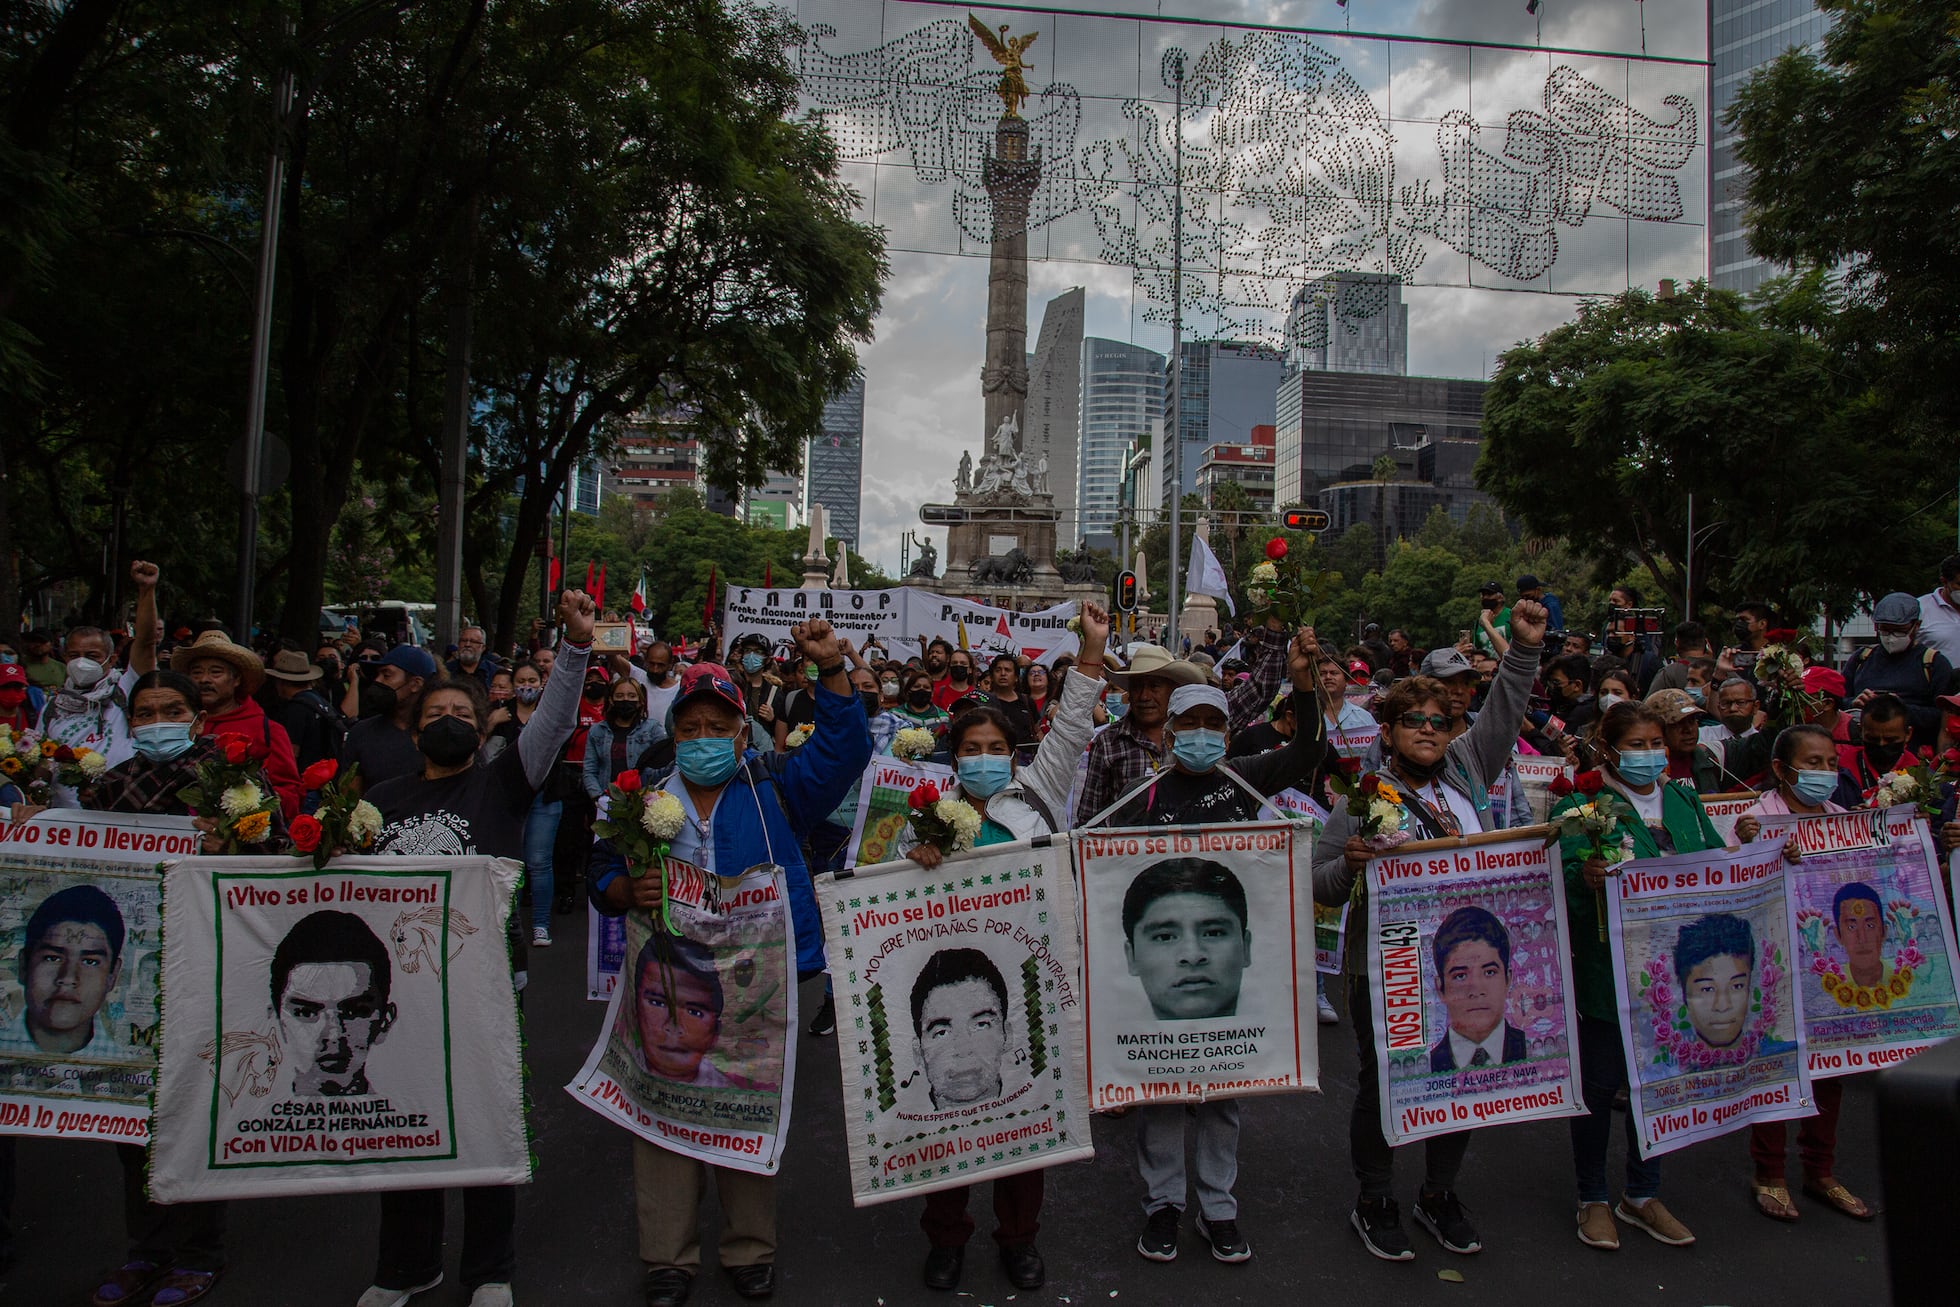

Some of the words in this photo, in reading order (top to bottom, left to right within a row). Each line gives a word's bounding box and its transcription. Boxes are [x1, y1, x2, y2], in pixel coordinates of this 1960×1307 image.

[729, 602, 757, 614] Frente
[761, 606, 806, 619] Nacional
[808, 611, 821, 619] de
[825, 610, 888, 621] Movimientos
[941, 604, 997, 627] Poder
[1008, 612, 1069, 632] Popular
[876, 768, 915, 788] ¡Vivo
[424, 809, 470, 828] ETADO
[1797, 820, 1826, 852] NOS
[1826, 813, 1871, 848] FALTAN
[46, 827, 71, 845] se
[77, 826, 98, 848] lo
[104, 828, 197, 855] llevaron!
[1086, 838, 1139, 860] ¡Vivo
[1145, 836, 1167, 855] se
[1173, 834, 1192, 853] lo
[1199, 831, 1286, 852] llevaron!
[1378, 860, 1423, 886] ¡Vivo
[1428, 858, 1449, 875] se
[1453, 852, 1471, 873] lo
[1475, 845, 1546, 871] llevaron!
[1622, 872, 1669, 898] ¡Vivo
[1674, 872, 1698, 888] se
[1705, 866, 1723, 886] lo
[1730, 857, 1783, 884] llevaron!
[227, 885, 280, 909] ¡Vivo
[286, 887, 307, 905] se
[314, 882, 334, 903] lo
[340, 881, 437, 903] llevaron!
[853, 911, 899, 935] ¡Vivo
[903, 907, 923, 922] se
[927, 900, 945, 919] lo
[948, 884, 1031, 915] llevaron!
[1381, 920, 1418, 947] 43!
[863, 933, 904, 983] MOVERE
[907, 919, 978, 944] MONTAÑAS
[984, 918, 1012, 935] POR
[1013, 926, 1077, 1012] ENCONTRARTE
[1384, 946, 1419, 1009] FALTAN
[1117, 1032, 1174, 1045] MARTÍN
[1178, 1027, 1266, 1044] GETSEMANY
[1388, 1011, 1421, 1048] NOS
[1813, 1022, 1855, 1036] Marcial
[1861, 1020, 1888, 1031] Pablo
[1893, 1013, 1934, 1026] Baranda
[1127, 1047, 1200, 1060] SÁNCHEZ
[1203, 1042, 1258, 1057] GARCÍA
[1846, 1050, 1863, 1066] lo
[20, 1064, 56, 1079] TOMÁS
[63, 1069, 103, 1081] COLÓN
[110, 1072, 153, 1086] GARNIC
[1148, 1066, 1185, 1075] EDAD
[1190, 1065, 1205, 1074] 20
[1209, 1061, 1245, 1072] AÑOS
[1426, 1077, 1457, 1092] JORGE
[1463, 1070, 1507, 1086] ÁLVAREZ
[1513, 1066, 1537, 1079] NAVA
[1654, 1085, 1680, 1099] JORGE
[1748, 1061, 1783, 1075] ENDOZA
[658, 1090, 707, 1109] MENDOZA
[714, 1101, 773, 1116] ZACARÍAS
[896, 1112, 923, 1121] NUNCA
[923, 1110, 960, 1122] ESPERES
[961, 1107, 978, 1117] QUE
[979, 1103, 990, 1112] TE
[991, 1082, 1033, 1109] OLVIDEMOS
[1099, 1083, 1135, 1105] ¡Con
[0, 1102, 30, 1128] IDA
[34, 1105, 53, 1128] lo
[237, 1117, 325, 1132] GONZÁLEZ
[328, 1113, 428, 1131] HERNÁNDEZ
[271, 1101, 325, 1117] CÉSAR
[328, 1100, 396, 1115] MANUEL
[591, 1080, 632, 1116] ¡Vivo
[636, 1110, 651, 1126] lo
[657, 1121, 763, 1155] queremos!
[1402, 1106, 1447, 1133] ¡Vivo
[1451, 1102, 1468, 1121] lo
[1473, 1086, 1564, 1121] queremos!
[1653, 1115, 1689, 1141] ¡Vivo
[1692, 1108, 1707, 1125] lo
[1713, 1085, 1790, 1124] queremos!
[223, 1136, 265, 1159] ¡Con
[270, 1134, 316, 1154] VIDA
[321, 1134, 337, 1152] lo
[341, 1130, 440, 1155] queremos!
[883, 1153, 916, 1176] ¡Con
[918, 1140, 956, 1162] VIDA
[958, 1137, 973, 1153] lo
[976, 1117, 1053, 1151] queremos!
